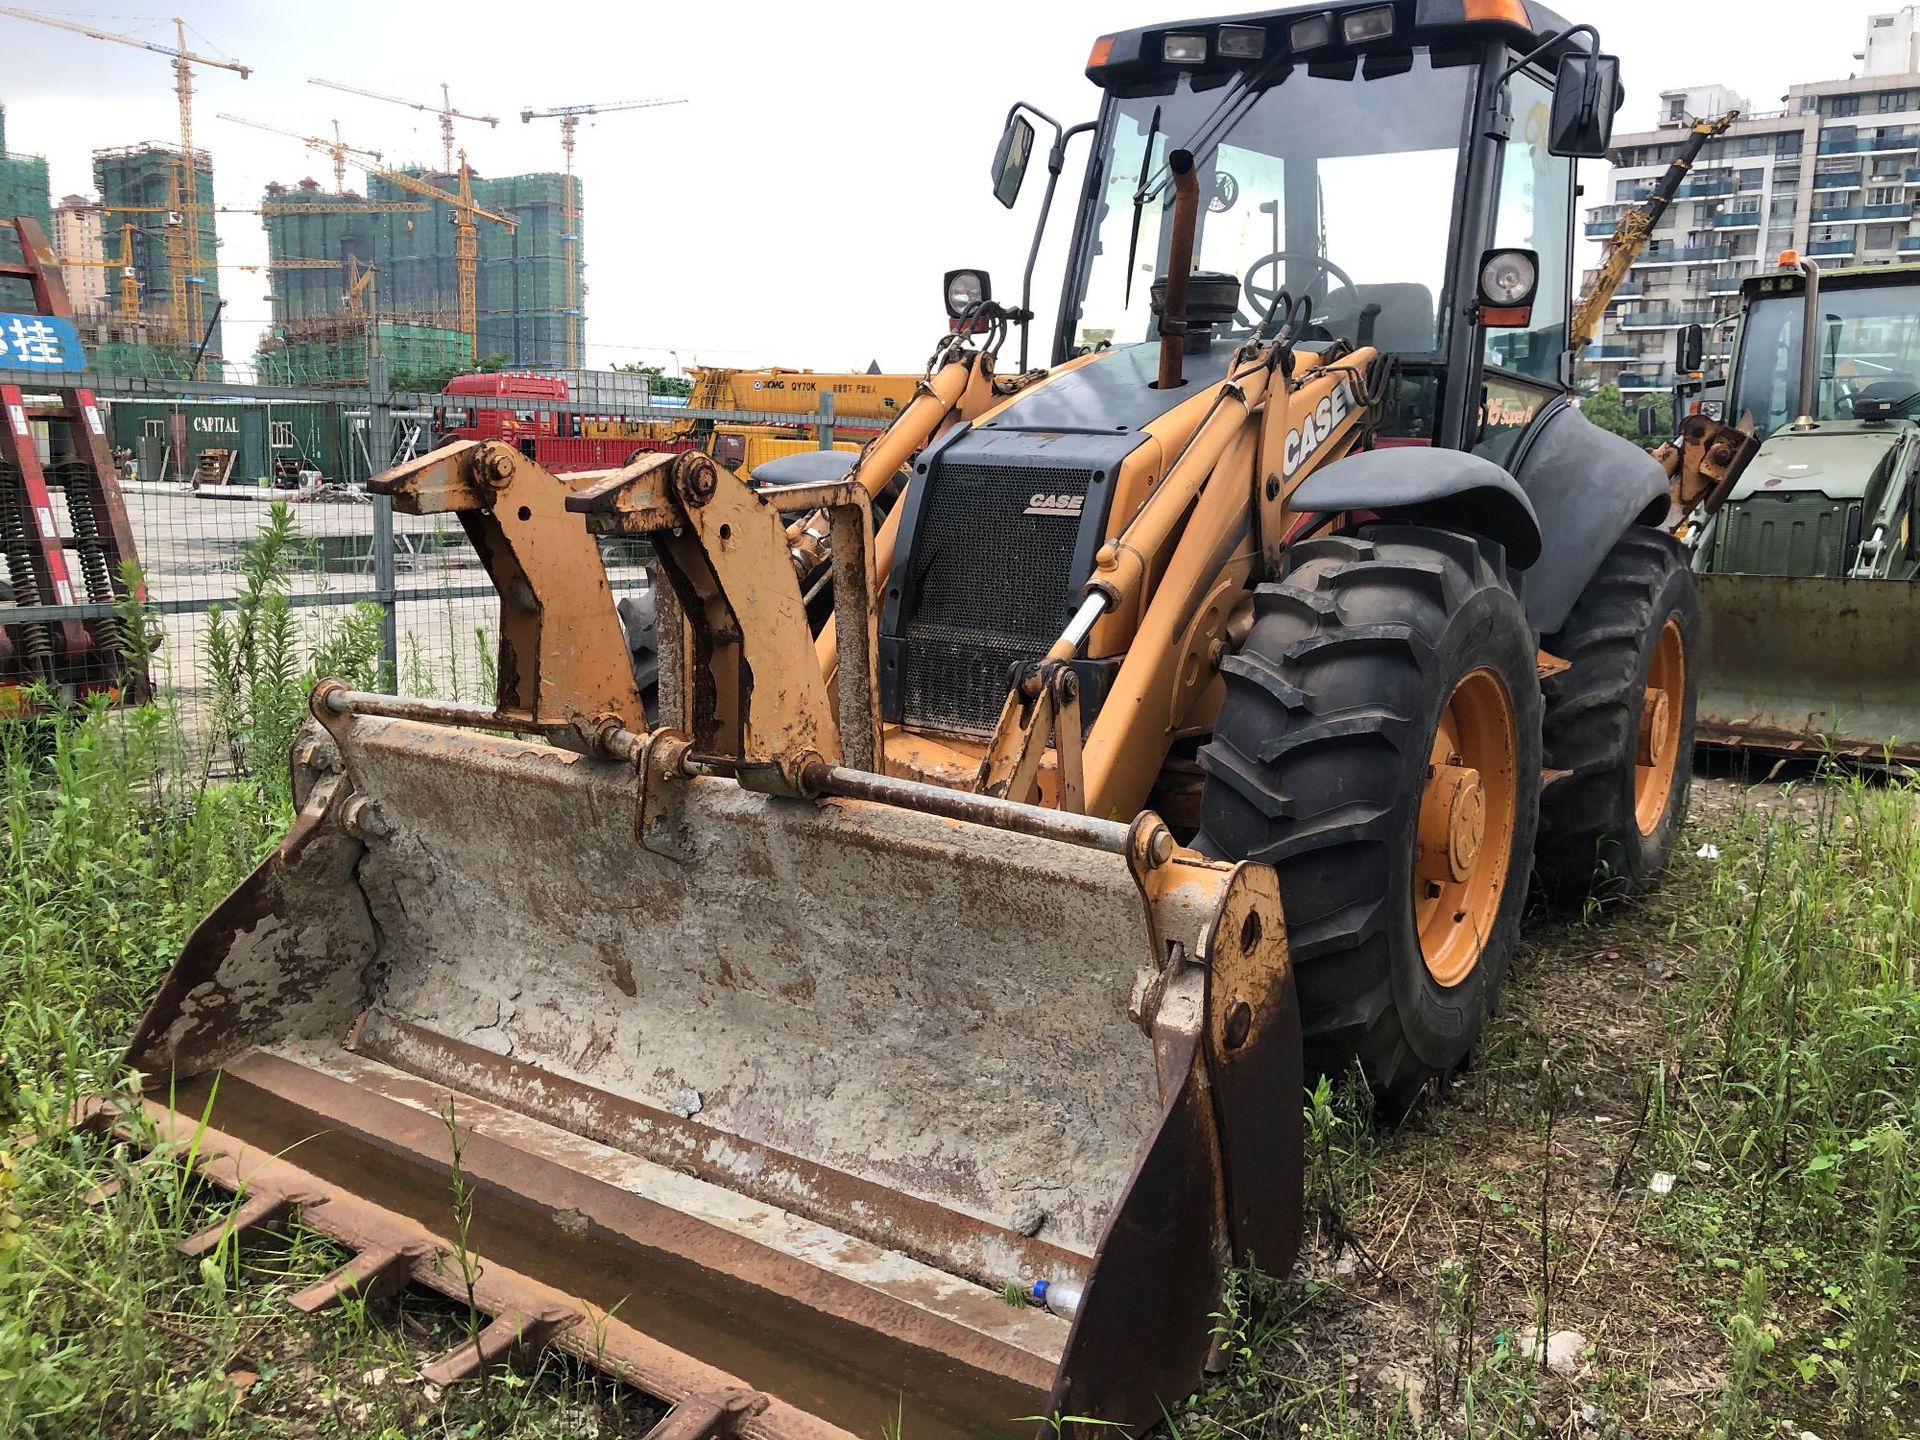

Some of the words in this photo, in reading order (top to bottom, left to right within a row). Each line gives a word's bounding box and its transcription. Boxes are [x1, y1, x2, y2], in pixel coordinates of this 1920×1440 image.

[0, 318, 64, 364] 挂
[791, 382, 817, 392] QY70K
[193, 416, 240, 433] CAPITAL
[1283, 380, 1347, 476] CASE
[1029, 493, 1085, 509] CASE
